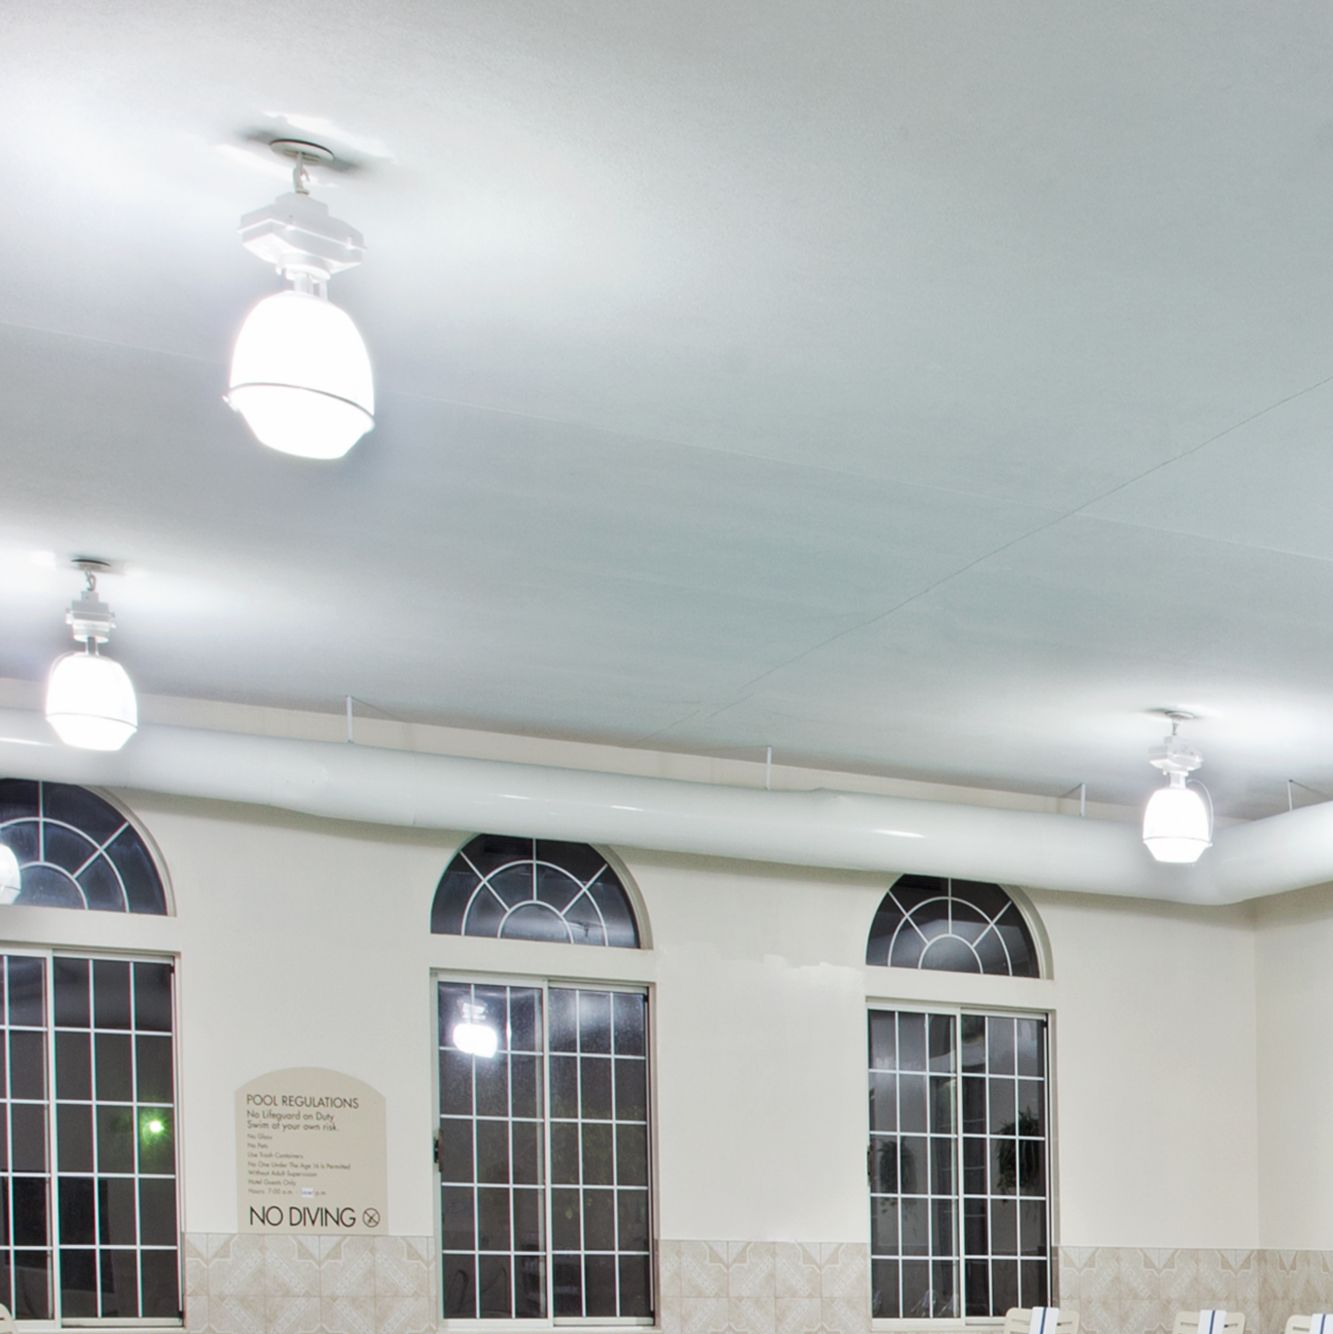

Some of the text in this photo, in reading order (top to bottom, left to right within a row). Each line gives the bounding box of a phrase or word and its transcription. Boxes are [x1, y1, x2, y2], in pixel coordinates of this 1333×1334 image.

[247, 1094, 359, 1109] POOL REGULATIONS
[247, 1110, 260, 1118] No
[262, 1110, 300, 1120] Lifeguard
[316, 1112, 334, 1122] Duty
[247, 1121, 268, 1129] Swim
[272, 1121, 280, 1129] at
[282, 1123, 300, 1132] your
[249, 1205, 356, 1228] NO DIVING
